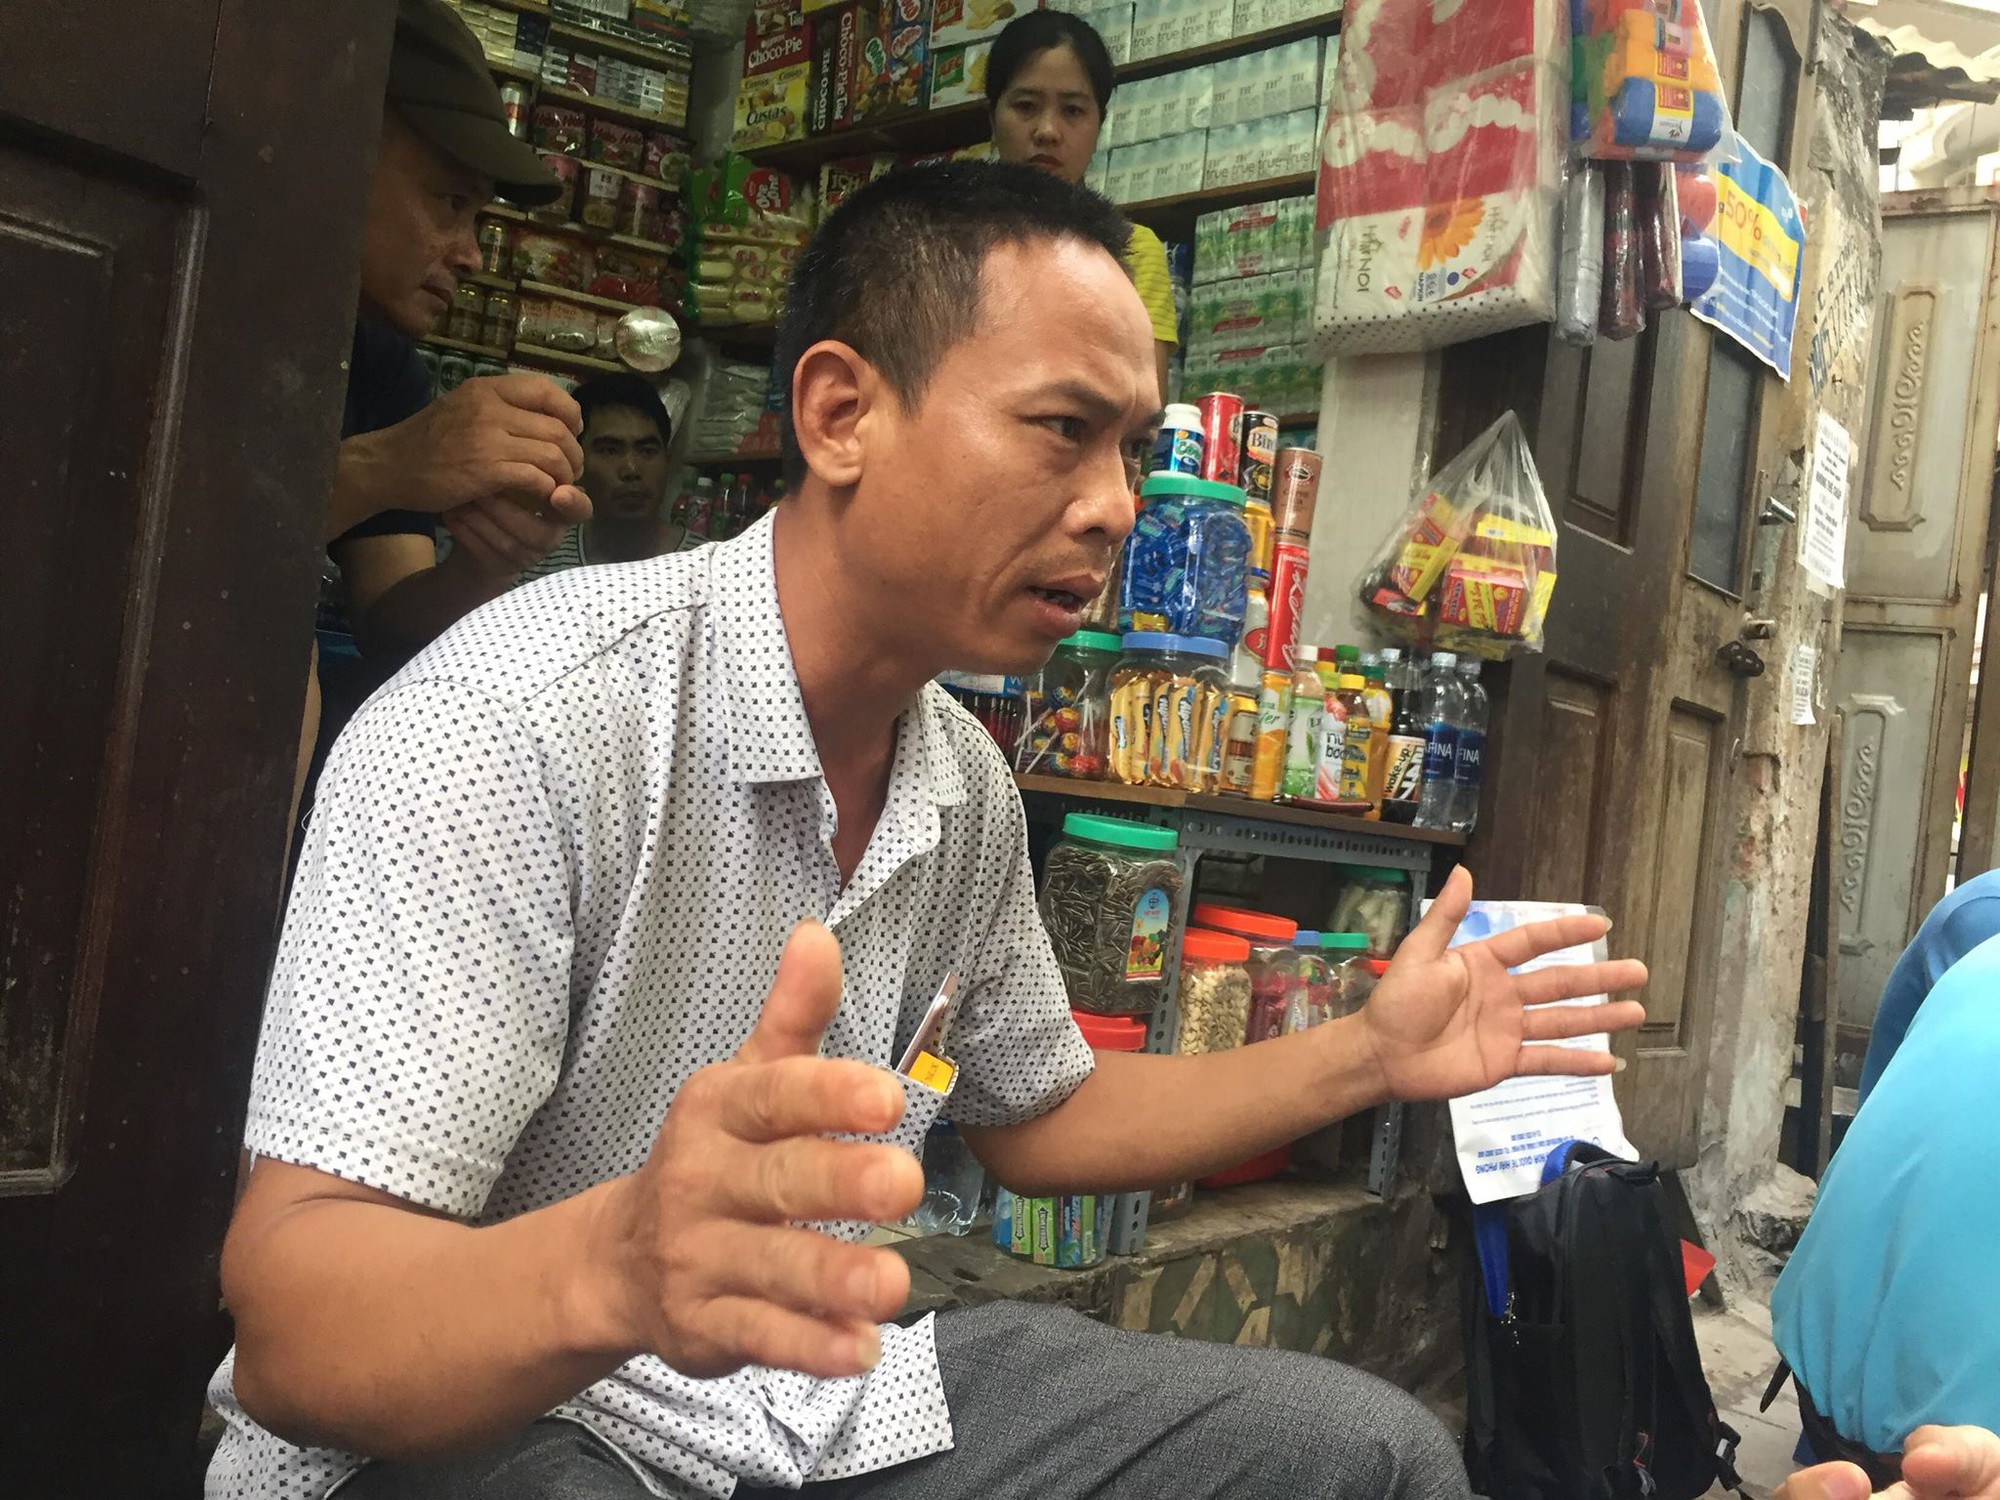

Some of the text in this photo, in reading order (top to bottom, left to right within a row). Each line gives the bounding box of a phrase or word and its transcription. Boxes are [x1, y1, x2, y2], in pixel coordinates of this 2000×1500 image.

[748, 36, 804, 69] Choco-Pie
[746, 106, 787, 126] Custas
[1727, 189, 1762, 241] 50%
